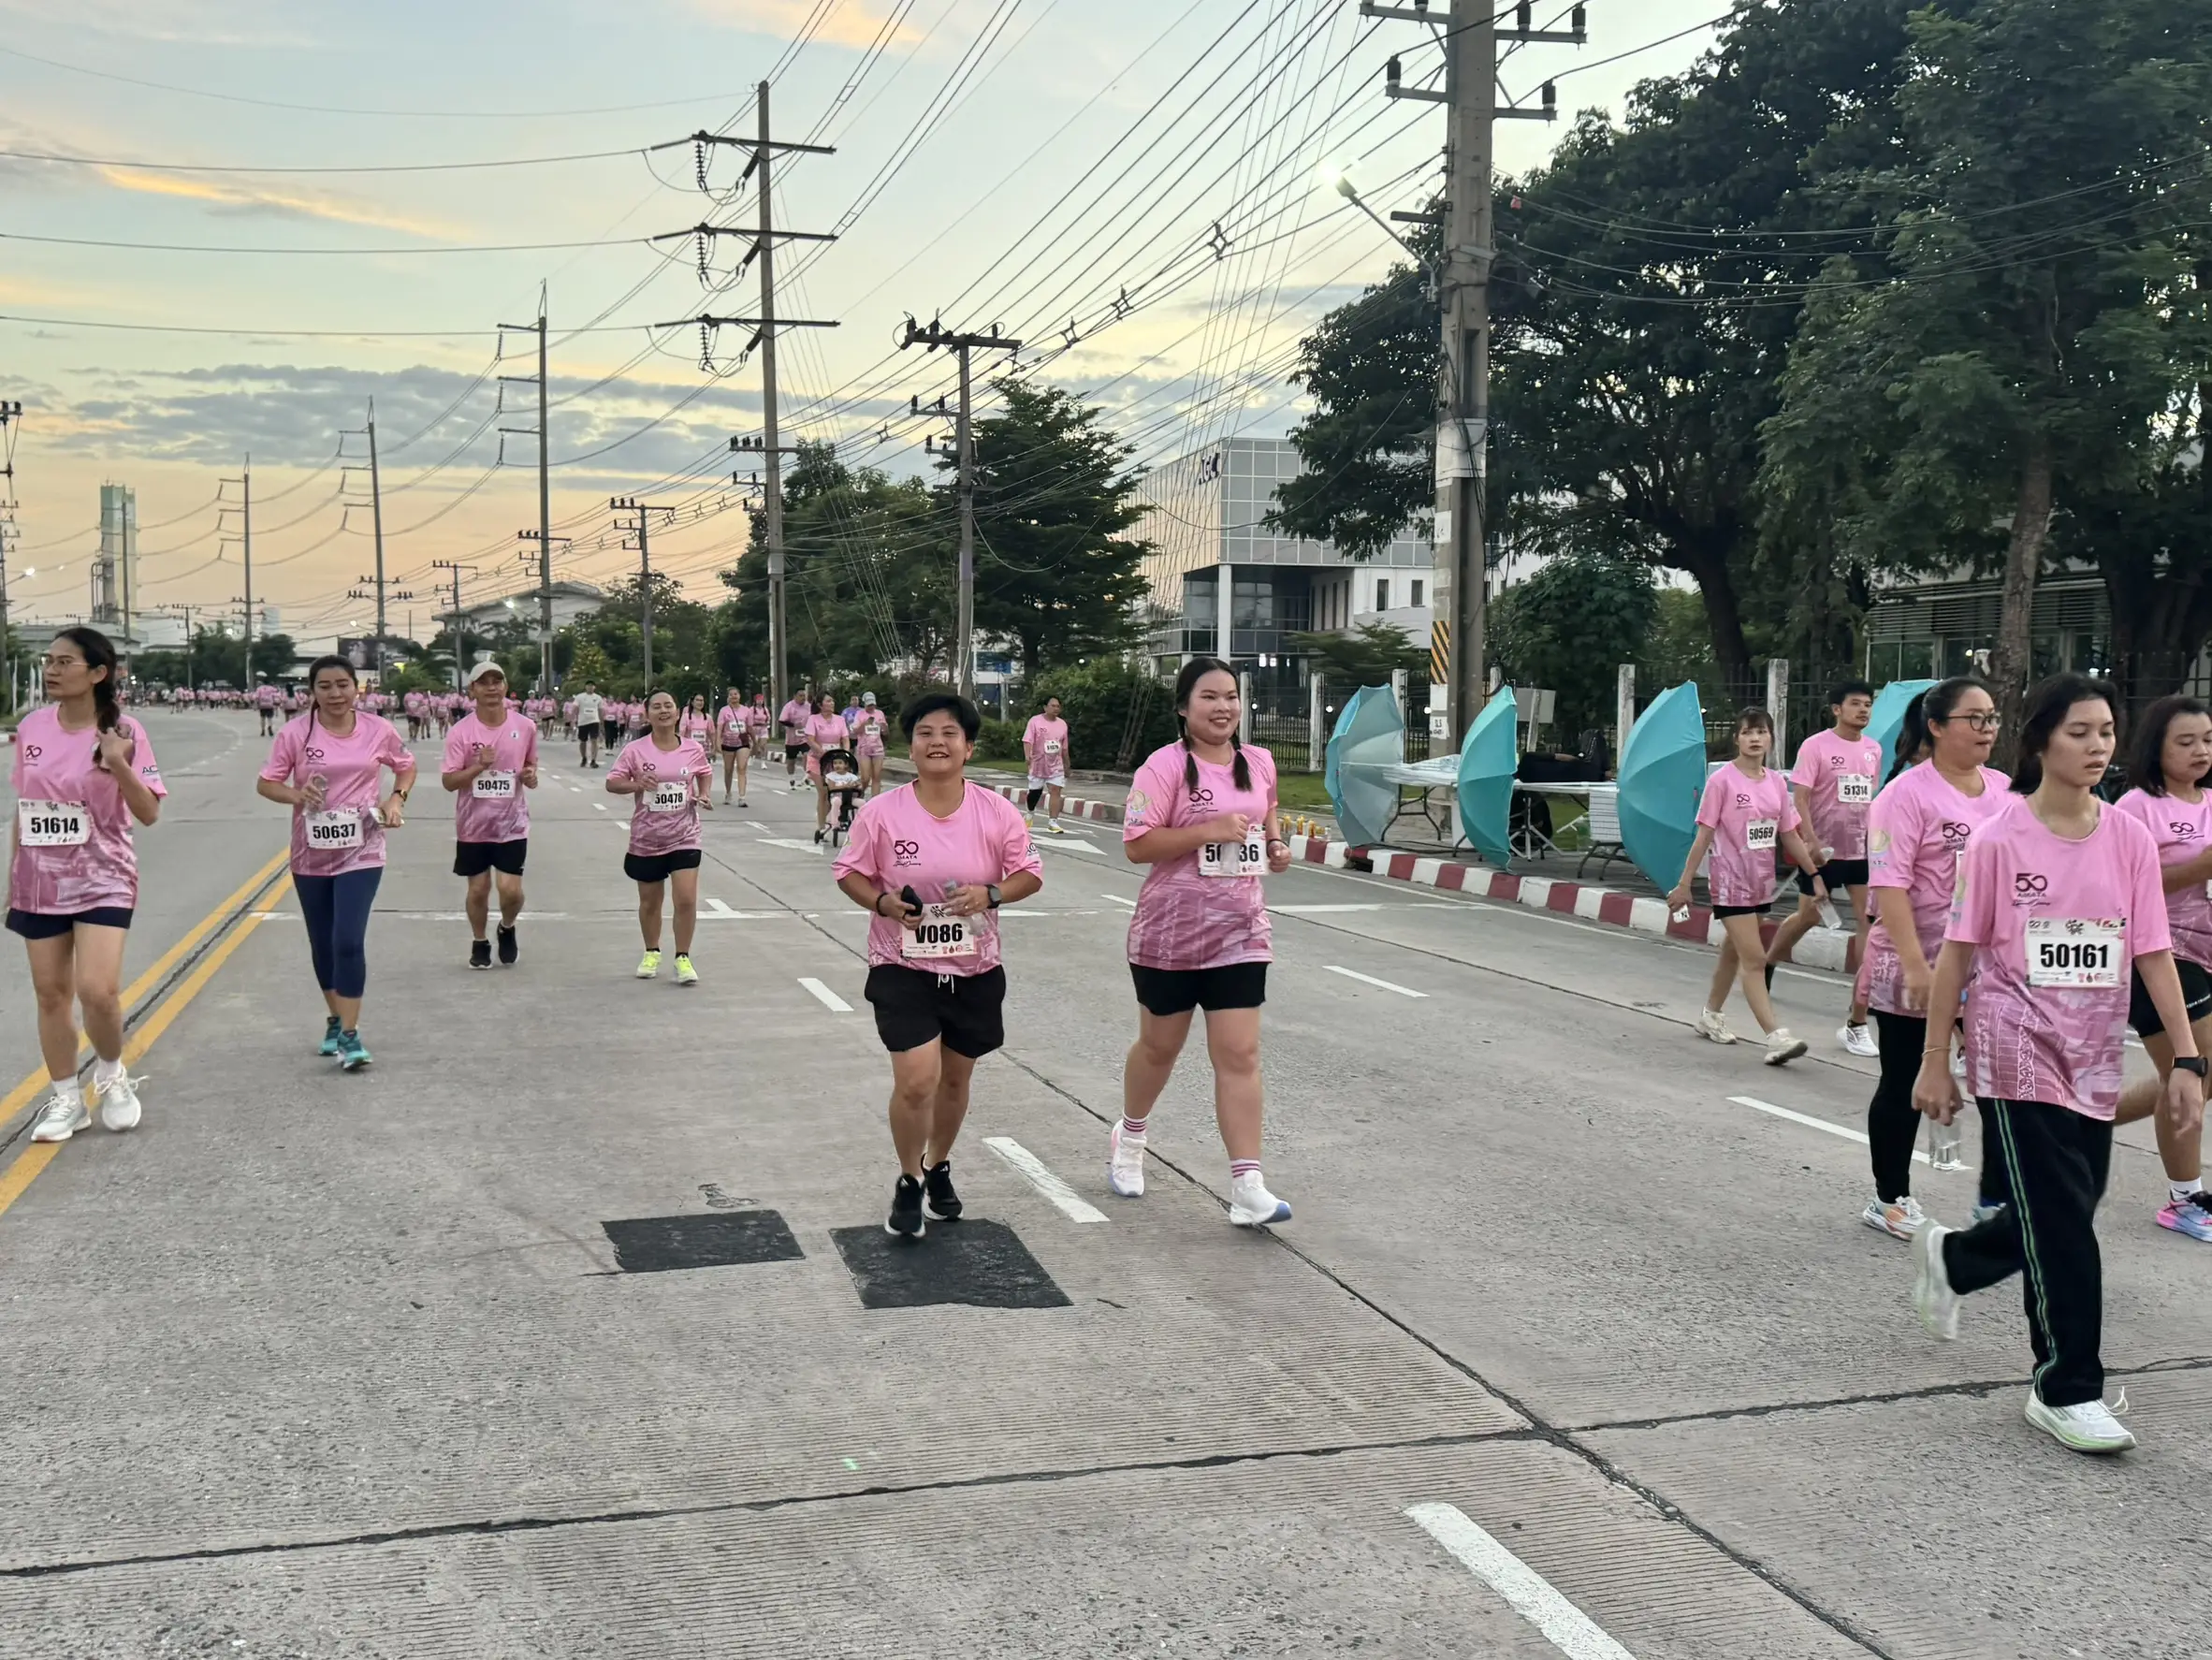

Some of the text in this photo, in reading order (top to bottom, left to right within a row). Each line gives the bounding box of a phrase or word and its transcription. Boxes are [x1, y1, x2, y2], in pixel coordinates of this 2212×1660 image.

[25, 745, 42, 757] 50
[306, 748, 324, 758] 50
[1831, 756, 1845, 764] 50
[642, 763, 655, 771] 50
[478, 780, 509, 790] 50475
[1844, 785, 1867, 796] 51314
[655, 793, 683, 804] 50478
[1736, 794, 1750, 803] 50
[31, 817, 79, 834] 51614
[313, 823, 356, 839] 50637
[1942, 822, 1971, 839] 50
[2170, 823, 2194, 833] 50
[1749, 827, 1774, 841] 50569
[894, 840, 919, 856] 50
[1206, 844, 1259, 862] 536
[2015, 873, 2048, 892] 50
[915, 923, 963, 944] V086
[2040, 943, 2108, 968] 50161
